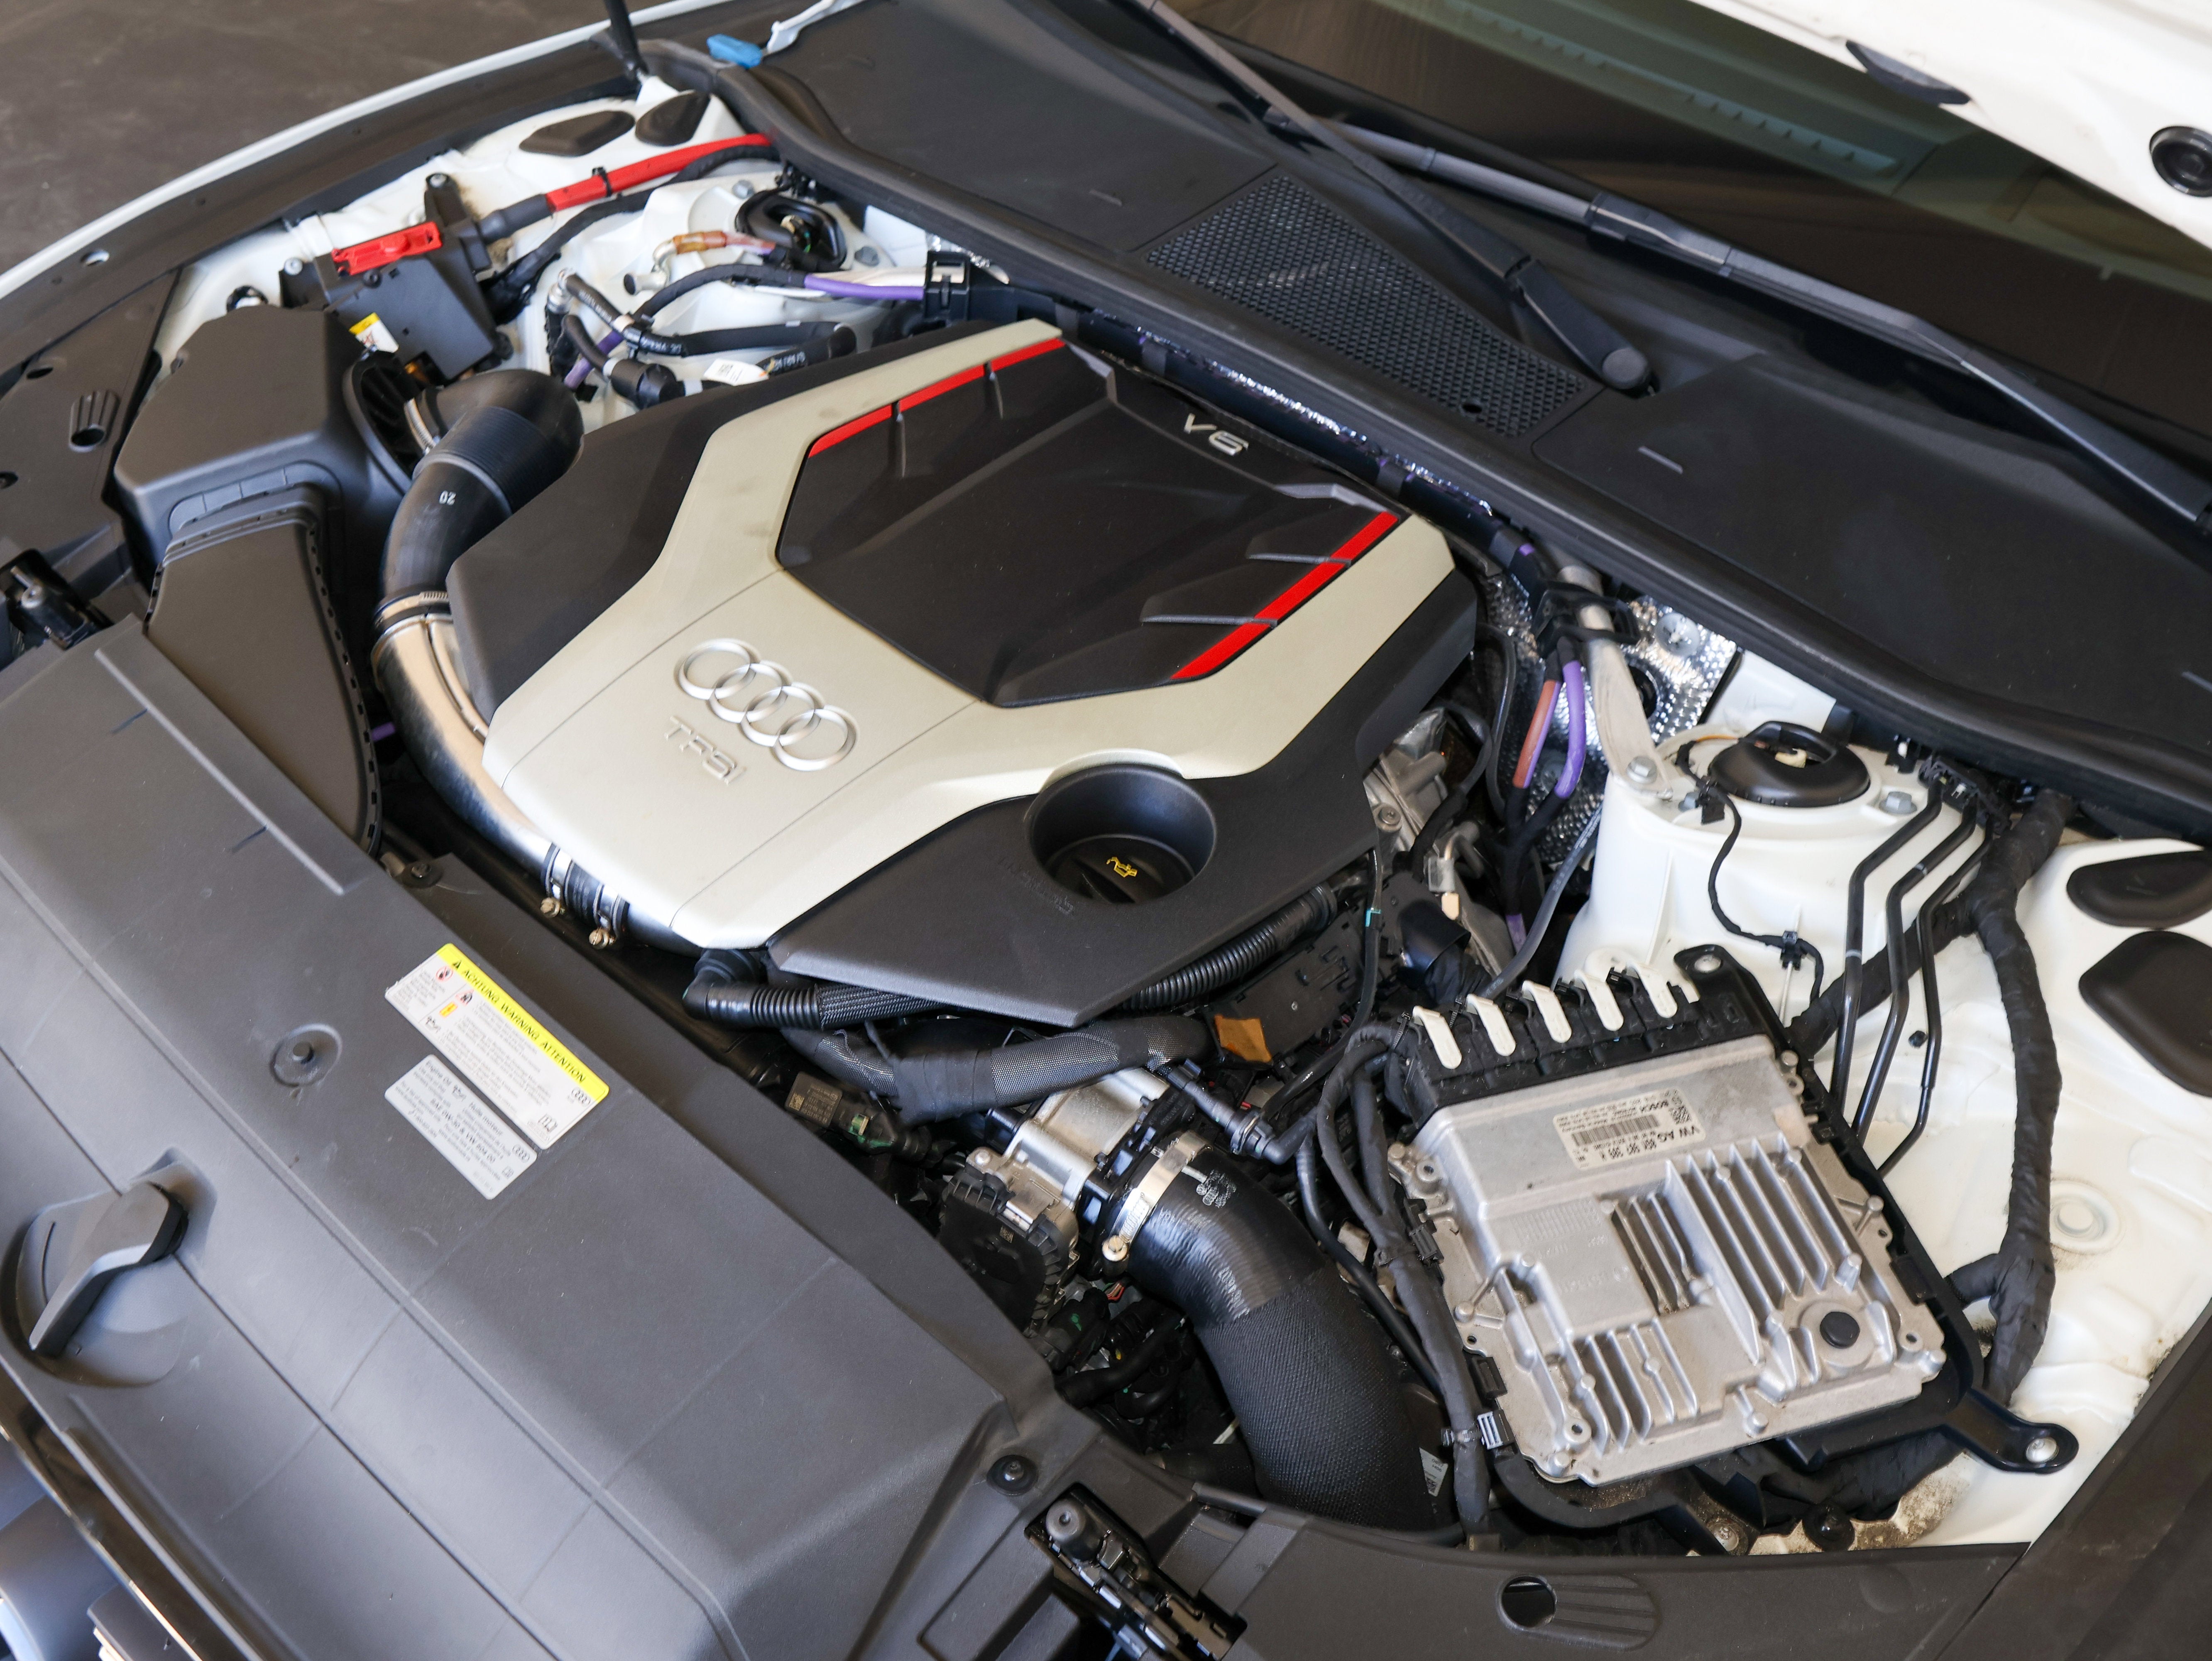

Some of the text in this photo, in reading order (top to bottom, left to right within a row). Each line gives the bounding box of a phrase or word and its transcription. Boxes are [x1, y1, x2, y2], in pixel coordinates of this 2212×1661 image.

[1182, 412, 1249, 456] V6
[664, 715, 746, 786] TFSI
[462, 970, 499, 1004] ACHTUNG
[501, 1002, 539, 1040] WARNING
[540, 1041, 586, 1083] ATTENTION
